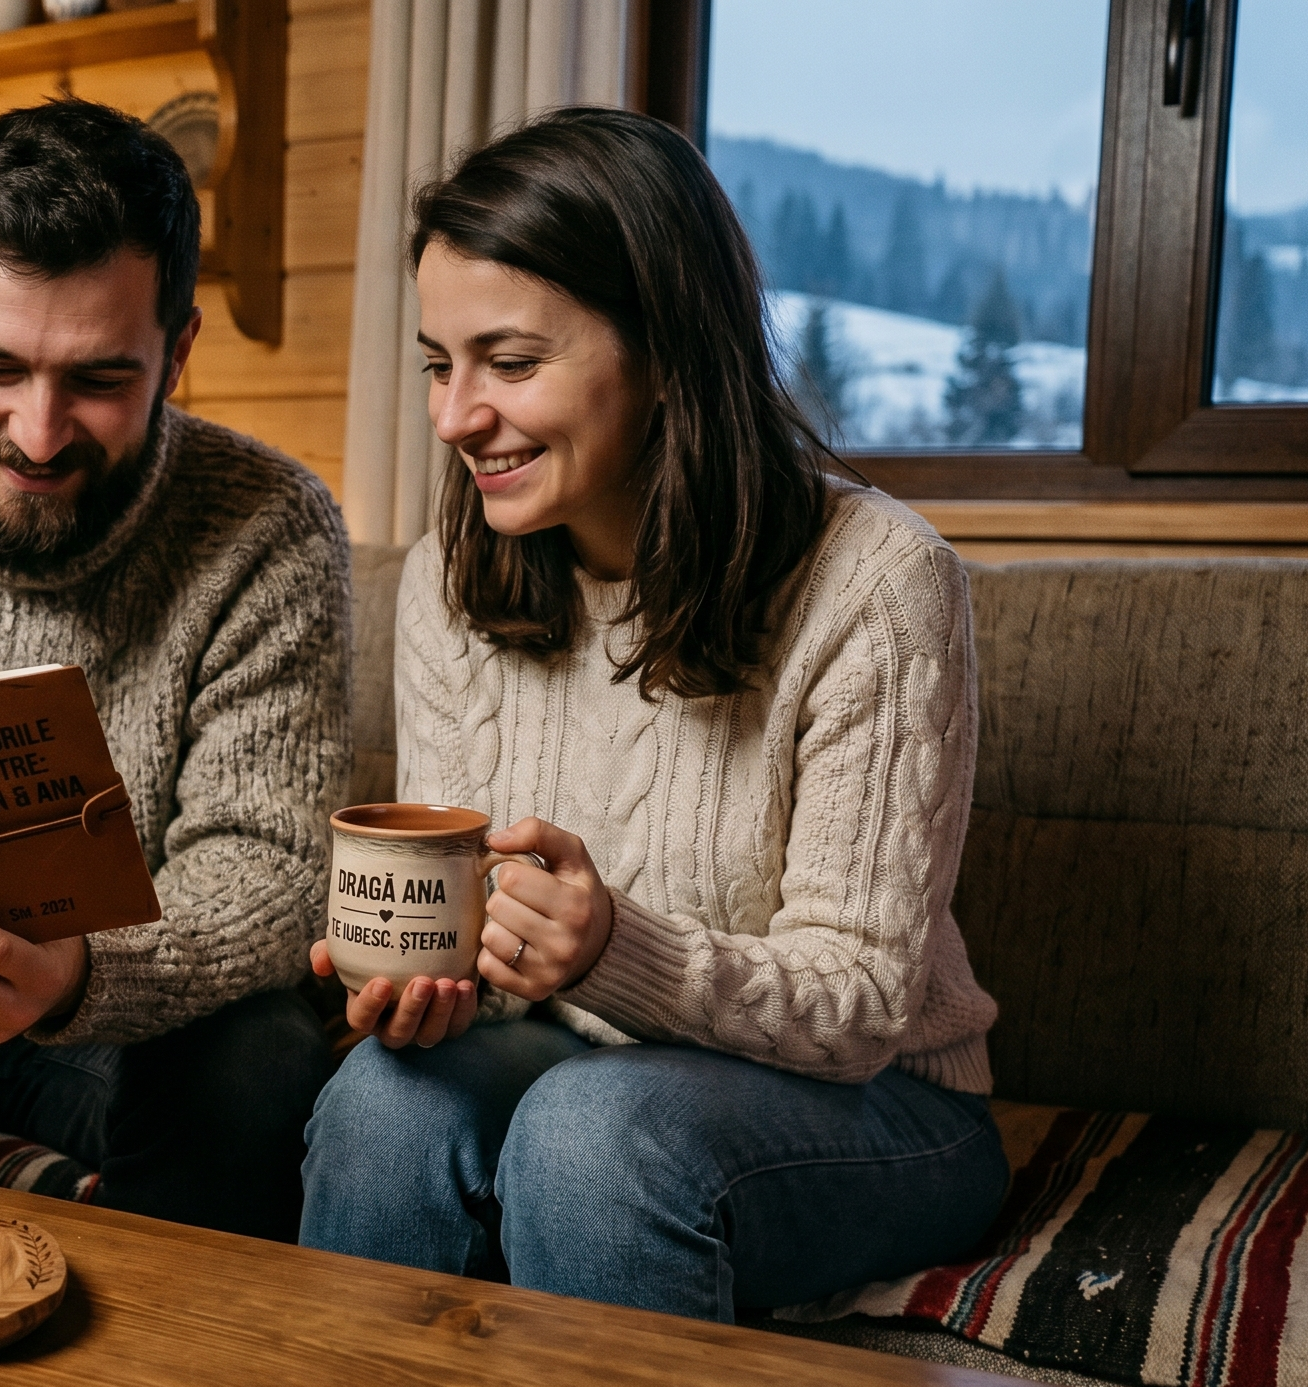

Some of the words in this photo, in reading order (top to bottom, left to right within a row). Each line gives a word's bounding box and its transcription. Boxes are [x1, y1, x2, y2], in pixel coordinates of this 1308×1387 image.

[12, 785, 31, 808] &
[37, 775, 87, 804] ANA
[338, 868, 396, 903] DRAGĂ
[402, 879, 447, 904] ANA
[40, 897, 76, 916] 2021
[332, 917, 341, 938] TE
[342, 922, 394, 949] IUBESC.
